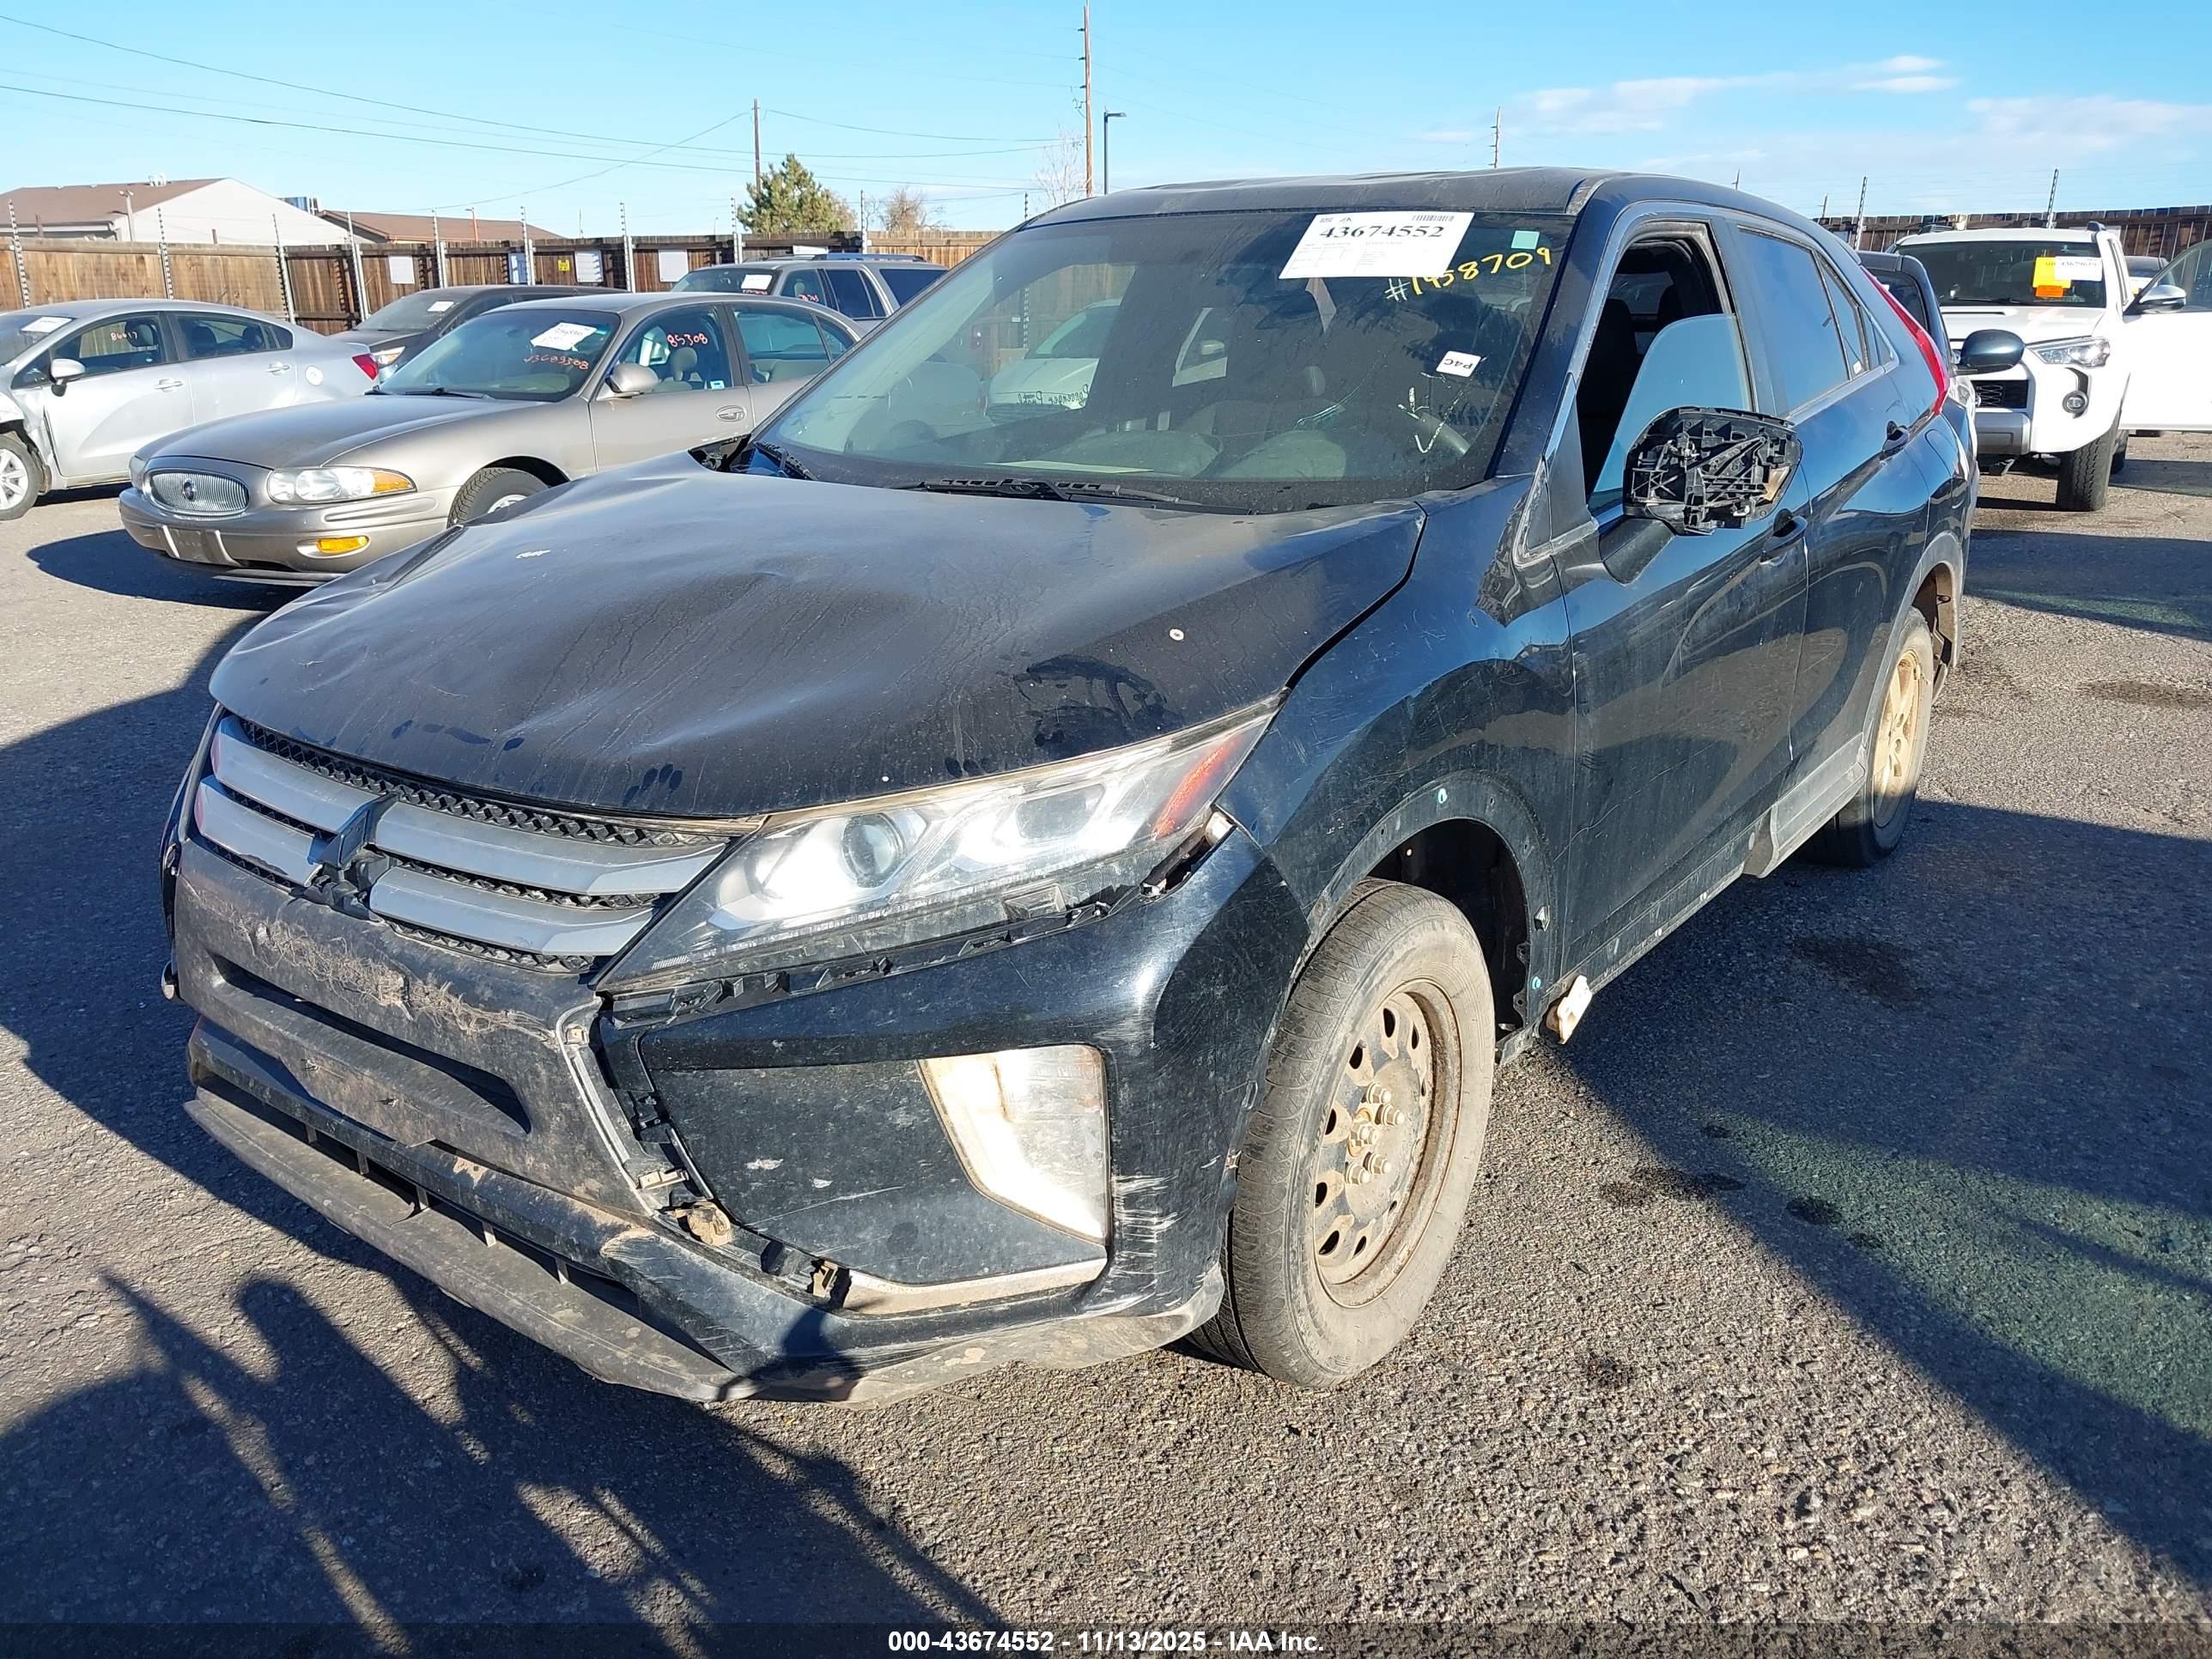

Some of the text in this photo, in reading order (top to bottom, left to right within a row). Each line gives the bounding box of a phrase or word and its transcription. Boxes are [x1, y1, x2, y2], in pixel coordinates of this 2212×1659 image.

[1320, 225, 1445, 239] 43674552
[666, 333, 708, 348] 85308
[1443, 359, 1474, 369] P4C
